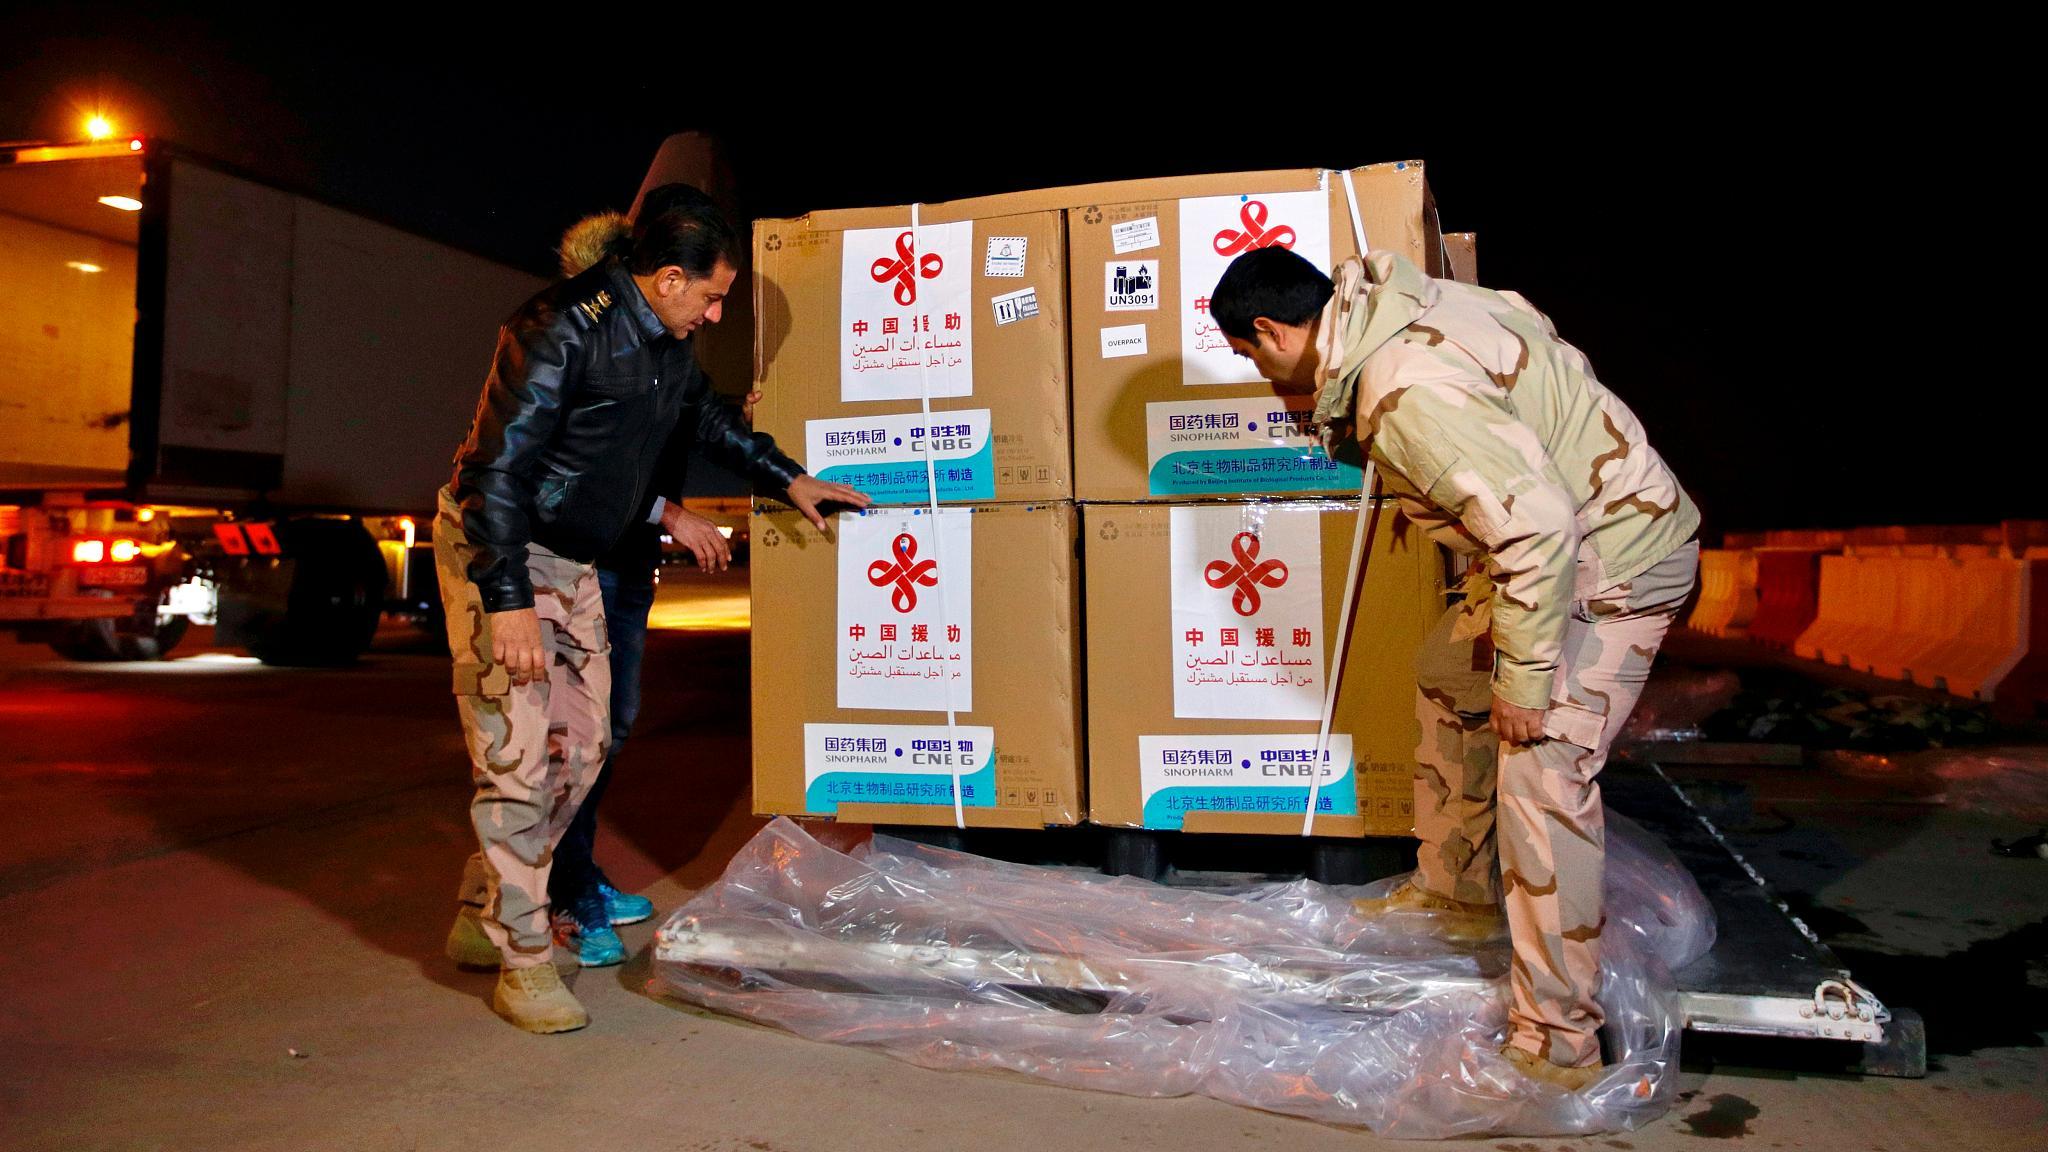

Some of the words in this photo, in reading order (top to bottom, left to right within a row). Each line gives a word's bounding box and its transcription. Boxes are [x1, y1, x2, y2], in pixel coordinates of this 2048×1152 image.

[1110, 295, 1154, 305] UN3091
[853, 336, 895, 358] الصين
[900, 335, 961, 352] مساعات
[1108, 338, 1142, 347] OVERPACK
[853, 359, 884, 373] مشترك
[887, 358, 921, 370] ستقبل
[926, 353, 945, 368] أجل
[948, 357, 962, 367] من
[1169, 413, 1239, 431] 国药集团
[826, 429, 886, 447] 国药集团
[1170, 432, 1240, 442] SINOPHARM
[827, 447, 887, 457] SINOPHARM
[1172, 457, 1308, 475] 北京生物制品研究所
[948, 467, 973, 482] 制造
[1207, 478, 1228, 486] Beijing
[849, 623, 961, 643] 中国援助
[1185, 627, 1311, 647] 中国援助
[849, 645, 892, 664] الصين
[1186, 650, 1234, 671] الصين
[1240, 650, 1312, 667] مساعدات
[849, 665, 882, 679] مشترك
[885, 665, 921, 679] مستقبل
[924, 665, 944, 680] أجل
[1186, 671, 1224, 686] مشترك
[1226, 672, 1268, 686] مستقبل
[1270, 671, 1292, 687] أجل
[1296, 676, 1312, 687] من
[825, 737, 887, 752] 国药集团
[912, 739, 973, 752] 中国生物
[825, 755, 887, 764] SINOPHARM
[1162, 749, 1232, 765] 国药集团
[1164, 768, 1233, 777] SINOPHARM
[827, 781, 946, 797] 北京生物制品研究所
[1166, 795, 1300, 811] 北京生物制品研究所
